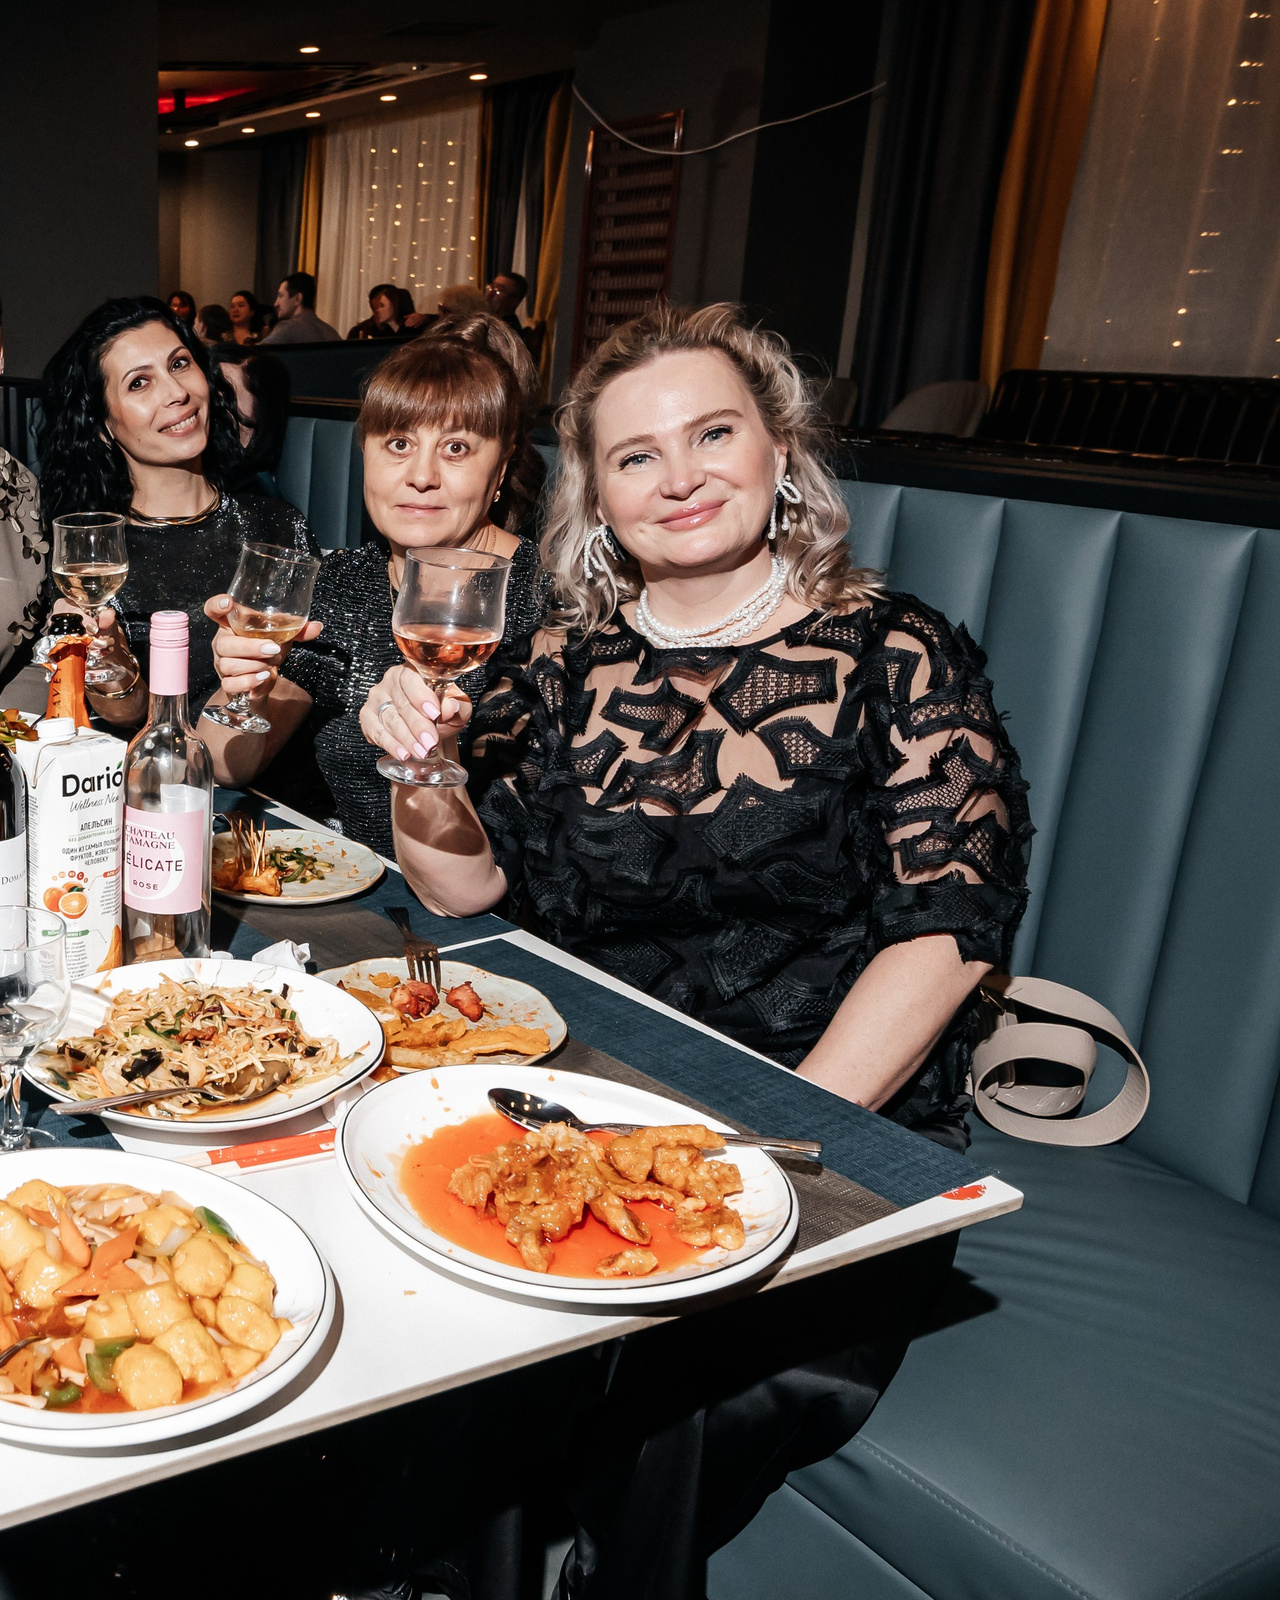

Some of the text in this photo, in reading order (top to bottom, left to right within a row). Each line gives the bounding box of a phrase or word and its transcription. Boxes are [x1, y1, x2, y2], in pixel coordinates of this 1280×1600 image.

[62, 761, 123, 798] Darió
[69, 797, 104, 812] Wellness
[80, 817, 113, 832] АПЕЛЬСИН
[125, 824, 175, 840] CHATEAU
[62, 847, 77, 855] ОДИН
[85, 841, 103, 851] САМЫХ
[125, 834, 176, 849] TAMAGNE
[70, 851, 94, 861] ФРУКТОВ,
[85, 856, 109, 866] ЧЕЛОВЕКУ
[125, 850, 183, 872] ÉLICATE
